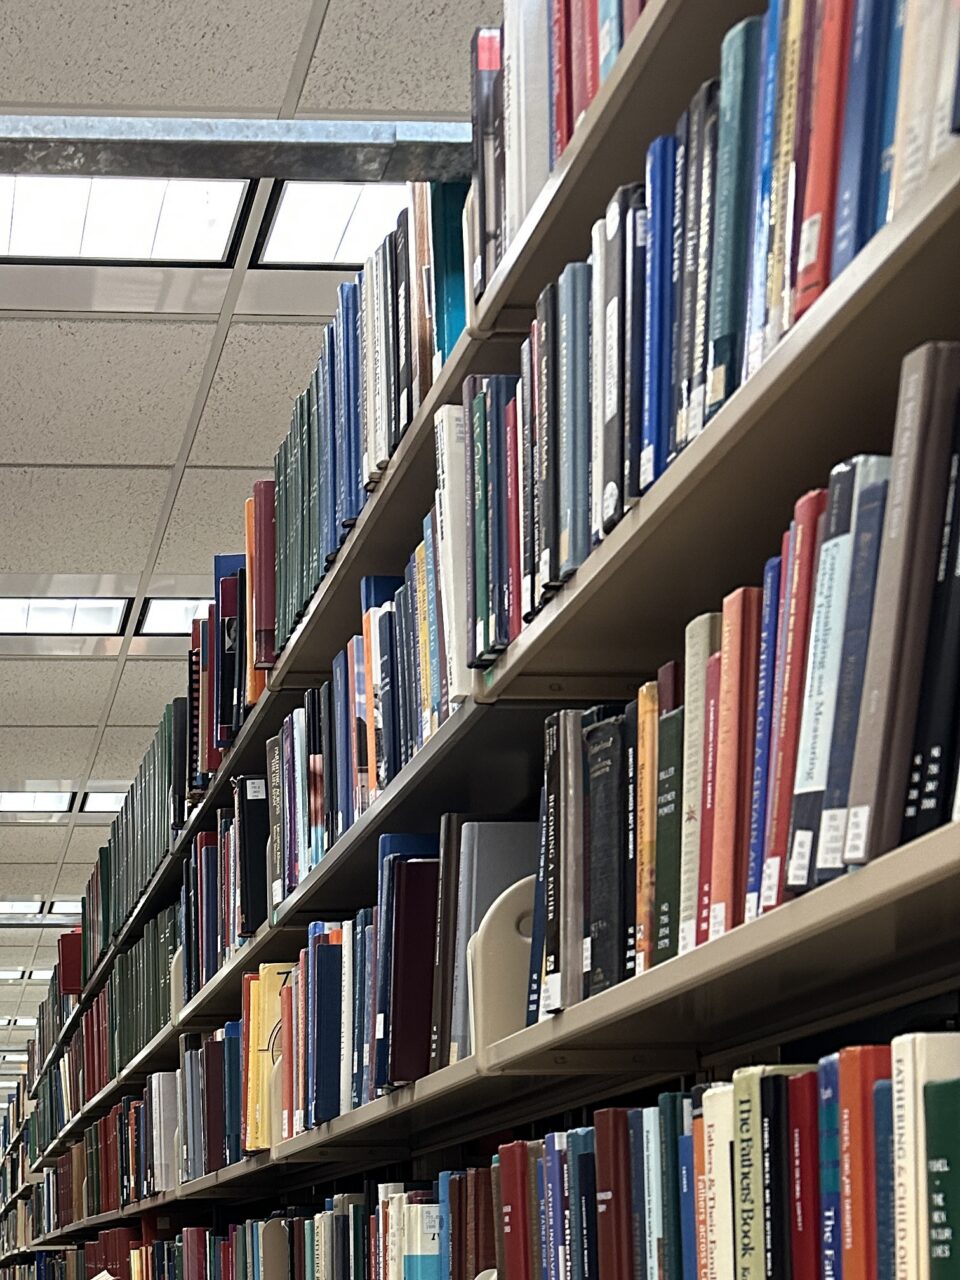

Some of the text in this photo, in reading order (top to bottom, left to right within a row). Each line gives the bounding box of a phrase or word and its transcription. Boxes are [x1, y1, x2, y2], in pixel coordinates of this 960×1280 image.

[807, 541, 841, 781] Conceptualizing and Measuring
[748, 631, 768, 886] FATHERS OF A CERTAIN AGE
[548, 794, 556, 859] BECOMING
[548, 877, 556, 921] FATHER
[739, 1098, 753, 1135] The
[896, 1057, 907, 1161] FATHERING
[707, 1123, 716, 1175] Fathers
[740, 1137, 755, 1205] Fathers'
[897, 1165, 907, 1179] &
[698, 1174, 708, 1221] Fathers
[708, 1191, 717, 1233] Their
[898, 1183, 909, 1242] CHILD
[699, 1223, 708, 1265] across
[741, 1208, 756, 1259] Book
[823, 1206, 835, 1243] The
